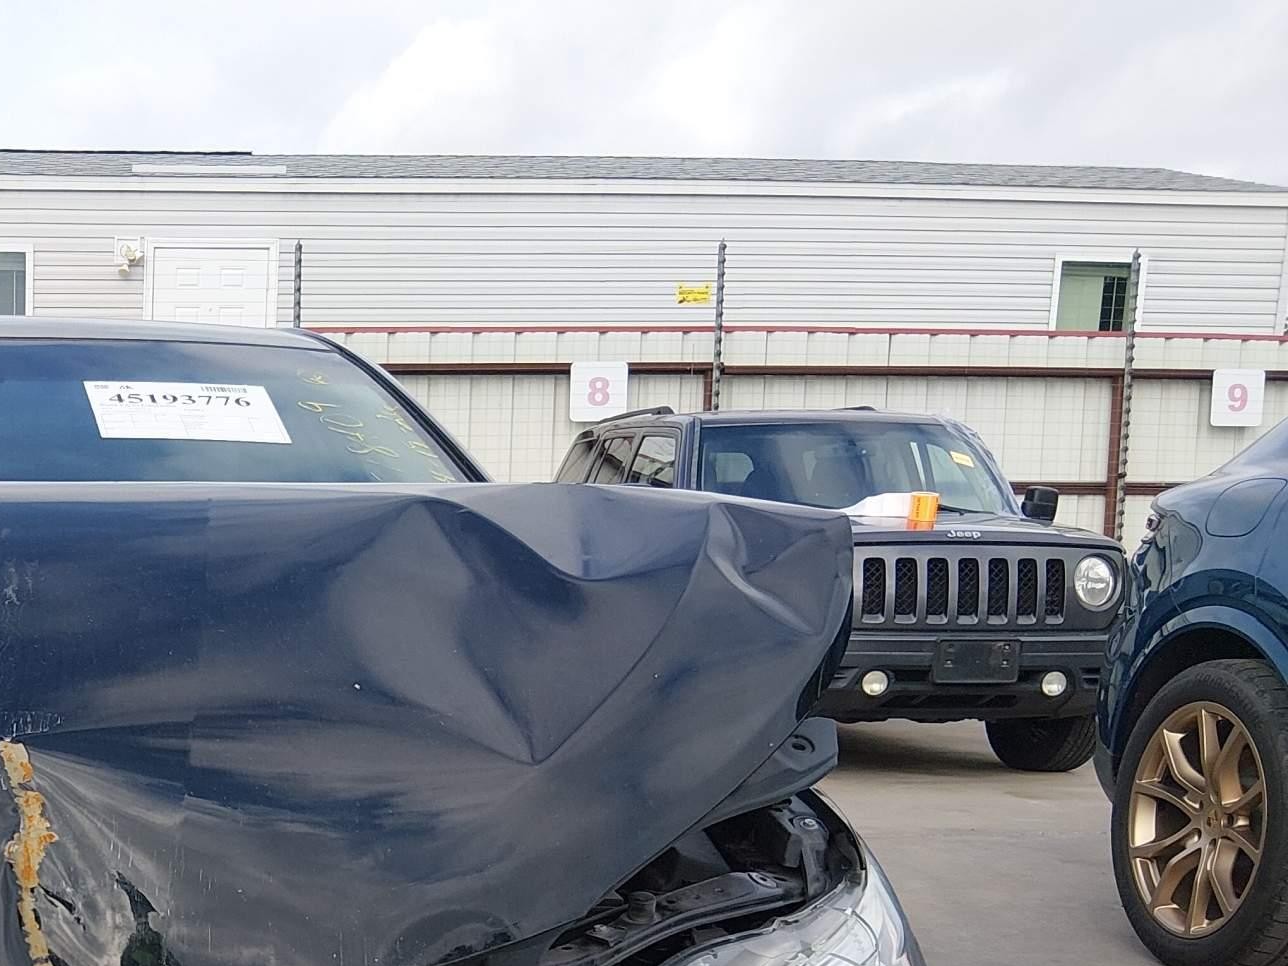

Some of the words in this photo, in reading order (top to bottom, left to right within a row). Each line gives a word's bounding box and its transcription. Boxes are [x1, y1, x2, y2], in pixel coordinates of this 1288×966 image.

[109, 393, 251, 407] 45193776
[588, 377, 609, 406] 8
[1228, 384, 1248, 412] 9
[946, 529, 981, 540] Jeep
